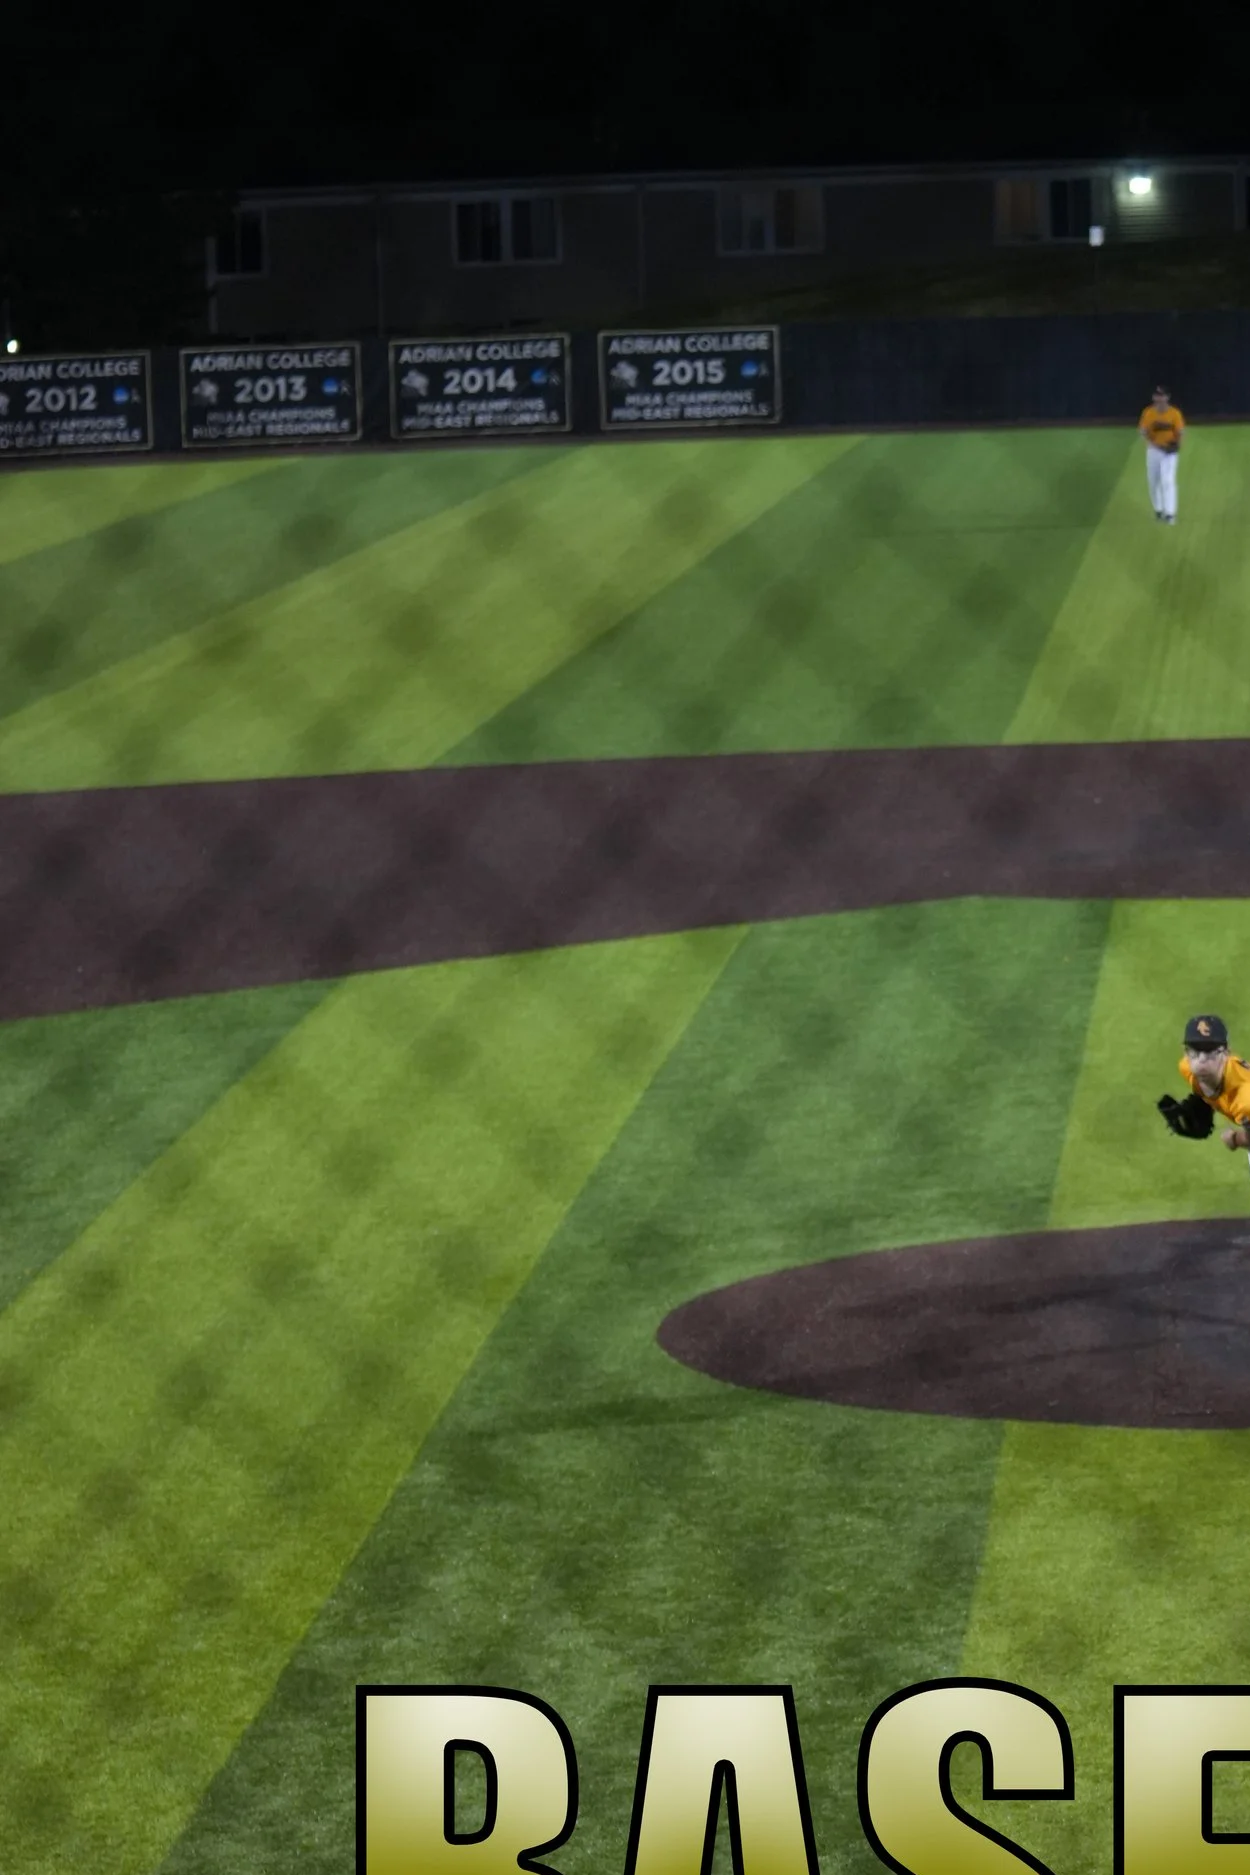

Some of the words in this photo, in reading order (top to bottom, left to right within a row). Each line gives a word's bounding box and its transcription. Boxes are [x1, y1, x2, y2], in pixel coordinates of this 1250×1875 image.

[399, 345, 472, 364] ADRIAN
[476, 340, 560, 360] COLLEGE
[608, 336, 681, 354] ADRIAN
[684, 332, 769, 352] COLLEGE
[0, 364, 52, 381] RIAN
[56, 360, 139, 379] COLLEGE
[190, 351, 263, 372] ADRIAN
[266, 350, 350, 369] COLLEGE
[652, 358, 726, 386] 2015
[234, 375, 307, 403] 2013
[443, 366, 517, 395] 2014
[25, 384, 97, 413] 2012
[0, 434, 53, 449] D-EAST
